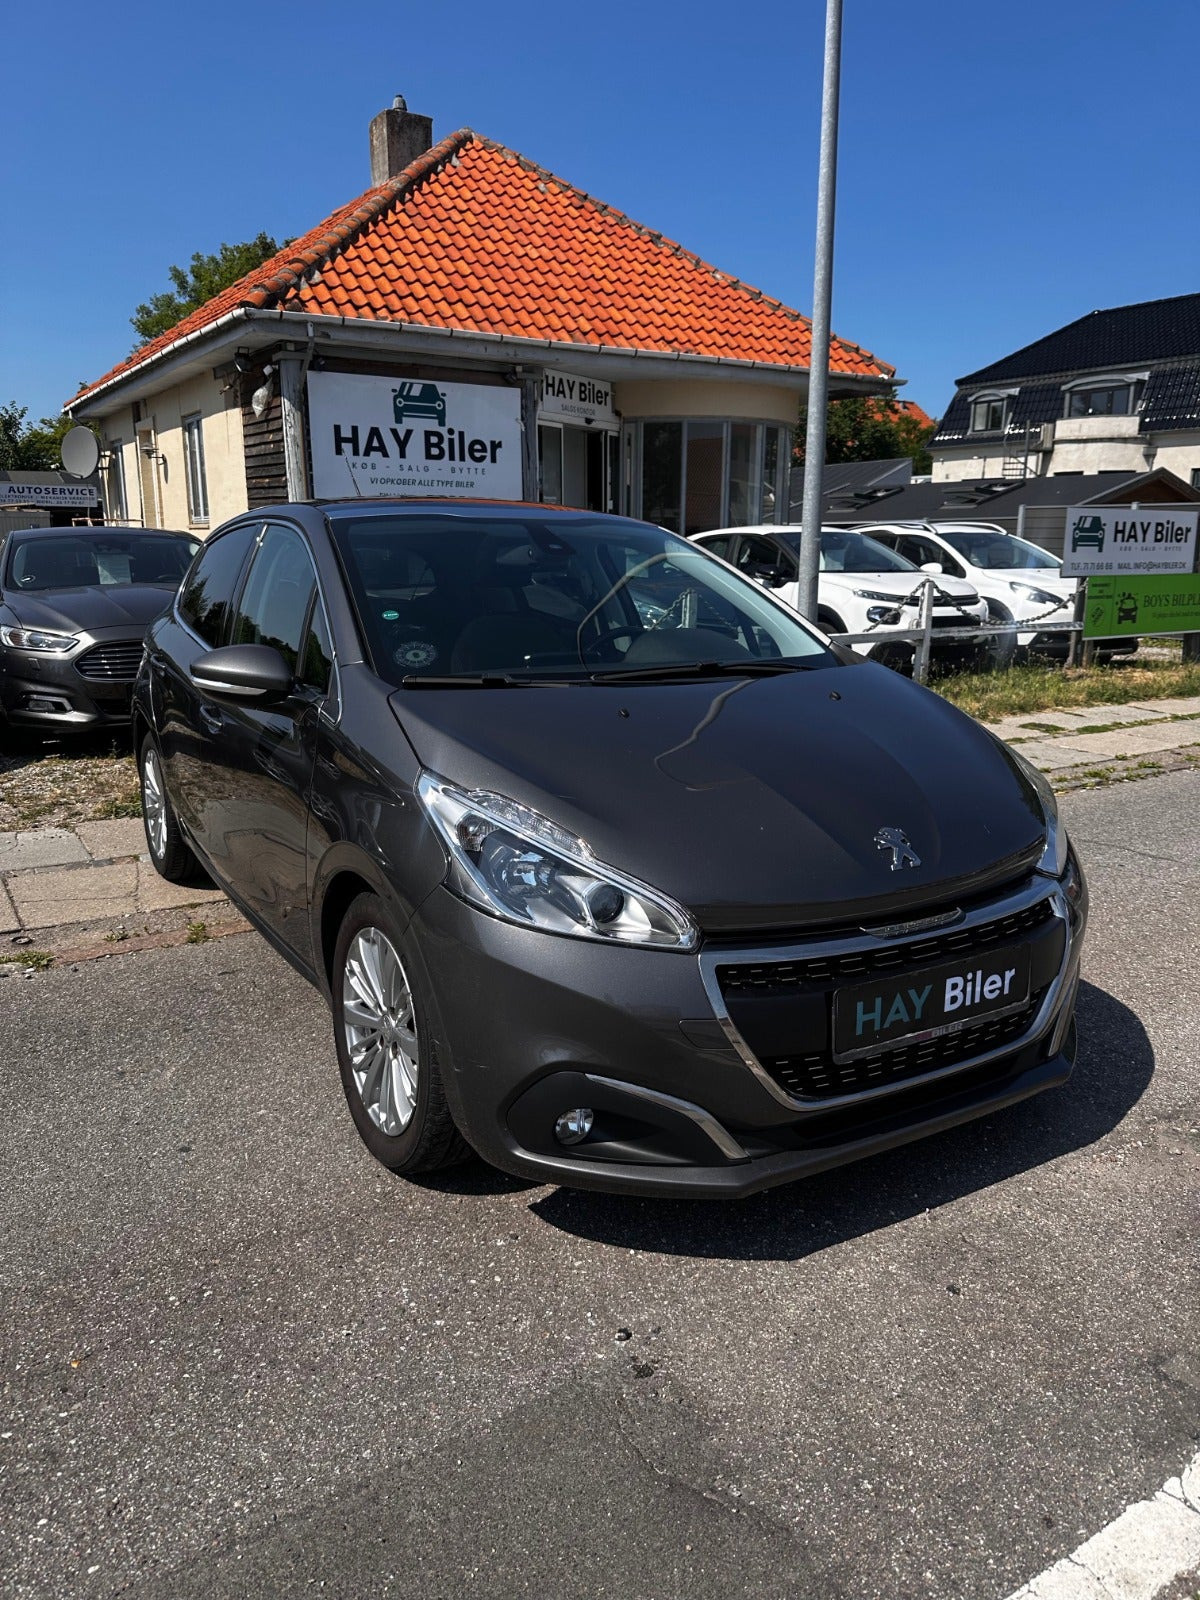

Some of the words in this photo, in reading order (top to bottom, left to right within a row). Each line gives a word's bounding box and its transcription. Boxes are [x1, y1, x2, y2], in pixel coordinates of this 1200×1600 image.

[545, 375, 576, 399] HAY
[579, 381, 610, 406] Biler
[333, 424, 414, 459] HAY
[424, 428, 503, 464] Biler
[370, 477, 379, 485] VI
[435, 480, 454, 488] TYPE
[455, 481, 475, 489] BILER
[399, 464, 430, 473] SALG
[450, 466, 487, 475] BYTTE
[1113, 521, 1151, 543] HAY
[1154, 520, 1192, 544] Biler
[855, 984, 933, 1036] HAY
[944, 968, 1016, 1013] Biler
